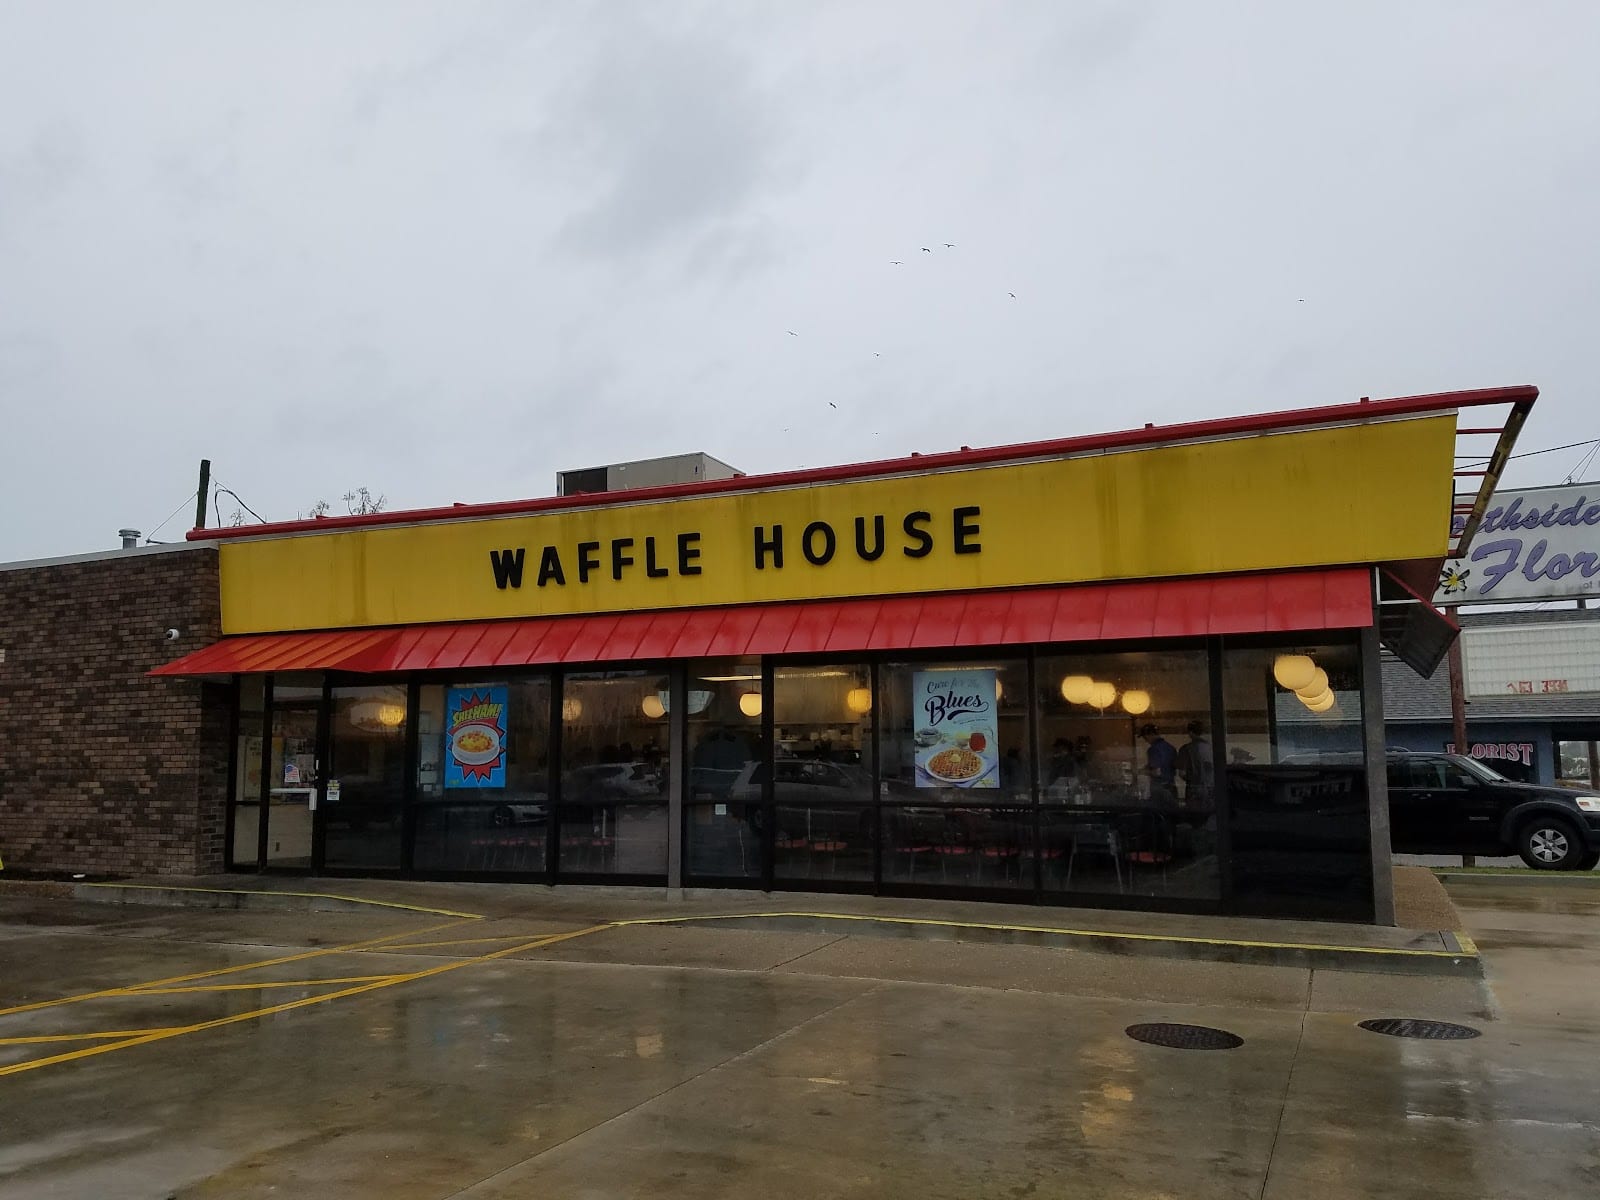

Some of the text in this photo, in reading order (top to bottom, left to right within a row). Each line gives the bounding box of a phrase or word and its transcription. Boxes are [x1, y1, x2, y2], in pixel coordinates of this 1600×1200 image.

[490, 506, 982, 590] WAFFLE HOUSE
[925, 690, 989, 726] Blues
[1446, 743, 1534, 767] FORIST
